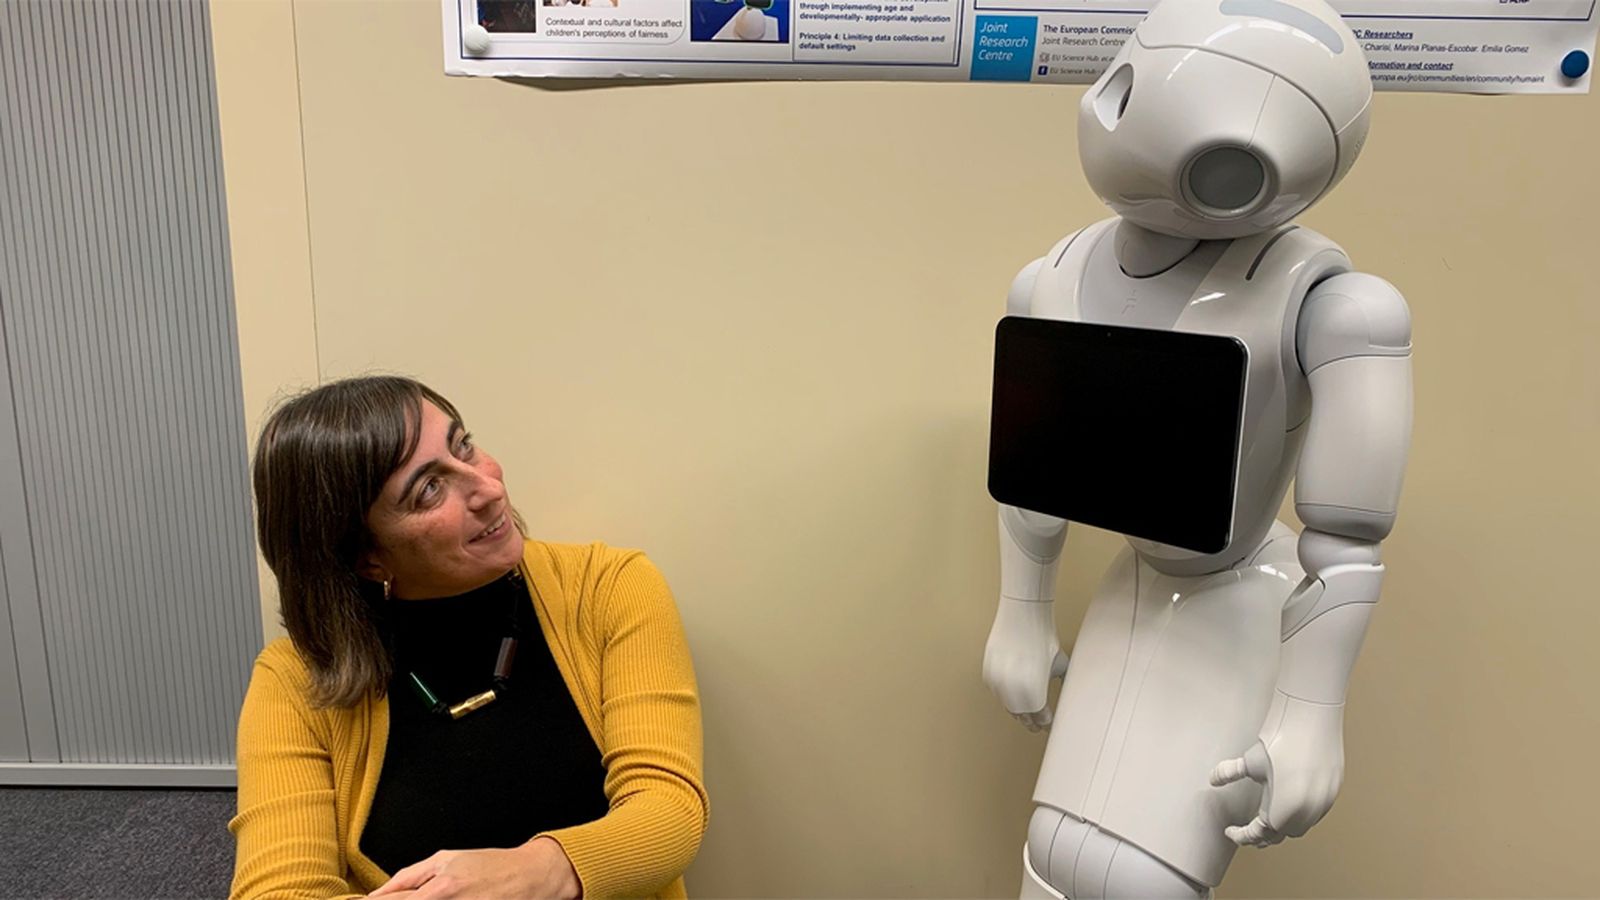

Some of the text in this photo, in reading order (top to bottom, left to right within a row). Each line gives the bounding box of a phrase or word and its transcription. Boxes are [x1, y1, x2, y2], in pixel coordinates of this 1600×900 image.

[800, 3, 829, 11] through
[832, 4, 882, 13] implementing
[884, 5, 897, 13] age
[545, 17, 585, 26] Contextual
[604, 18, 631, 26] cultural
[633, 19, 659, 27] factors
[661, 19, 682, 28] affect
[866, 14, 908, 22] appropriate
[910, 14, 951, 23] application
[980, 21, 1009, 33] Joint
[1043, 25, 1136, 35] The European Commis
[583, 30, 626, 38] perceptions
[629, 30, 637, 38] of
[638, 30, 668, 39] fairness
[800, 32, 831, 41] Principle
[843, 33, 873, 42] Limiting
[893, 34, 929, 42] collection
[1364, 29, 1413, 39] Researchers
[799, 42, 856, 51] default settings
[979, 36, 1029, 48] Research
[1041, 37, 1125, 46] Joint Research Centre
[1394, 43, 1419, 51] Marina
[1481, 44, 1503, 53] Emilia
[1504, 44, 1529, 53] Gomez
[978, 49, 1014, 61] Centre
[1062, 54, 1084, 62] Science
[1368, 60, 1454, 71] formation and contact
[1060, 67, 1082, 75] Science
